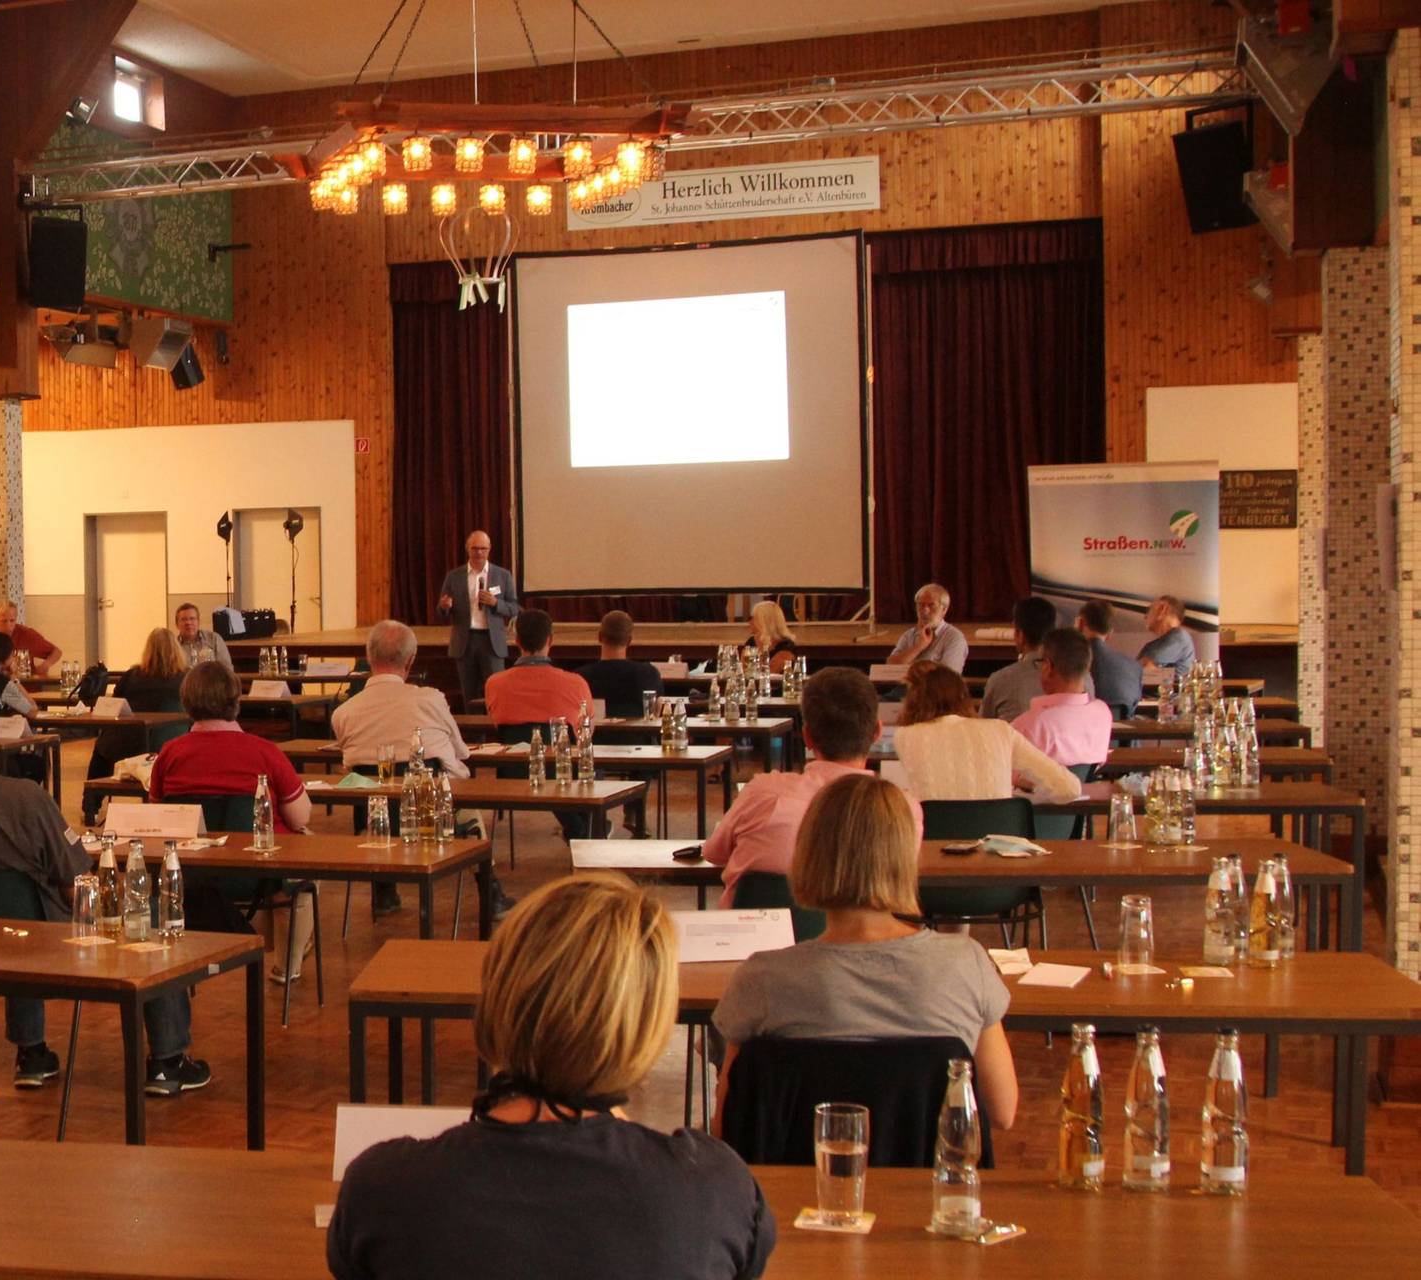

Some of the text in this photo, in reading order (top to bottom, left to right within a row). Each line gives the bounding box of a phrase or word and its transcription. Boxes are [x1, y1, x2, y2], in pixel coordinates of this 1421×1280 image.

[662, 172, 855, 199] Herzlich Willkommen
[651, 189, 867, 214] St. Johannes Schützenbruderschaft e.V. Altenbüren
[1225, 473, 1255, 489] 110
